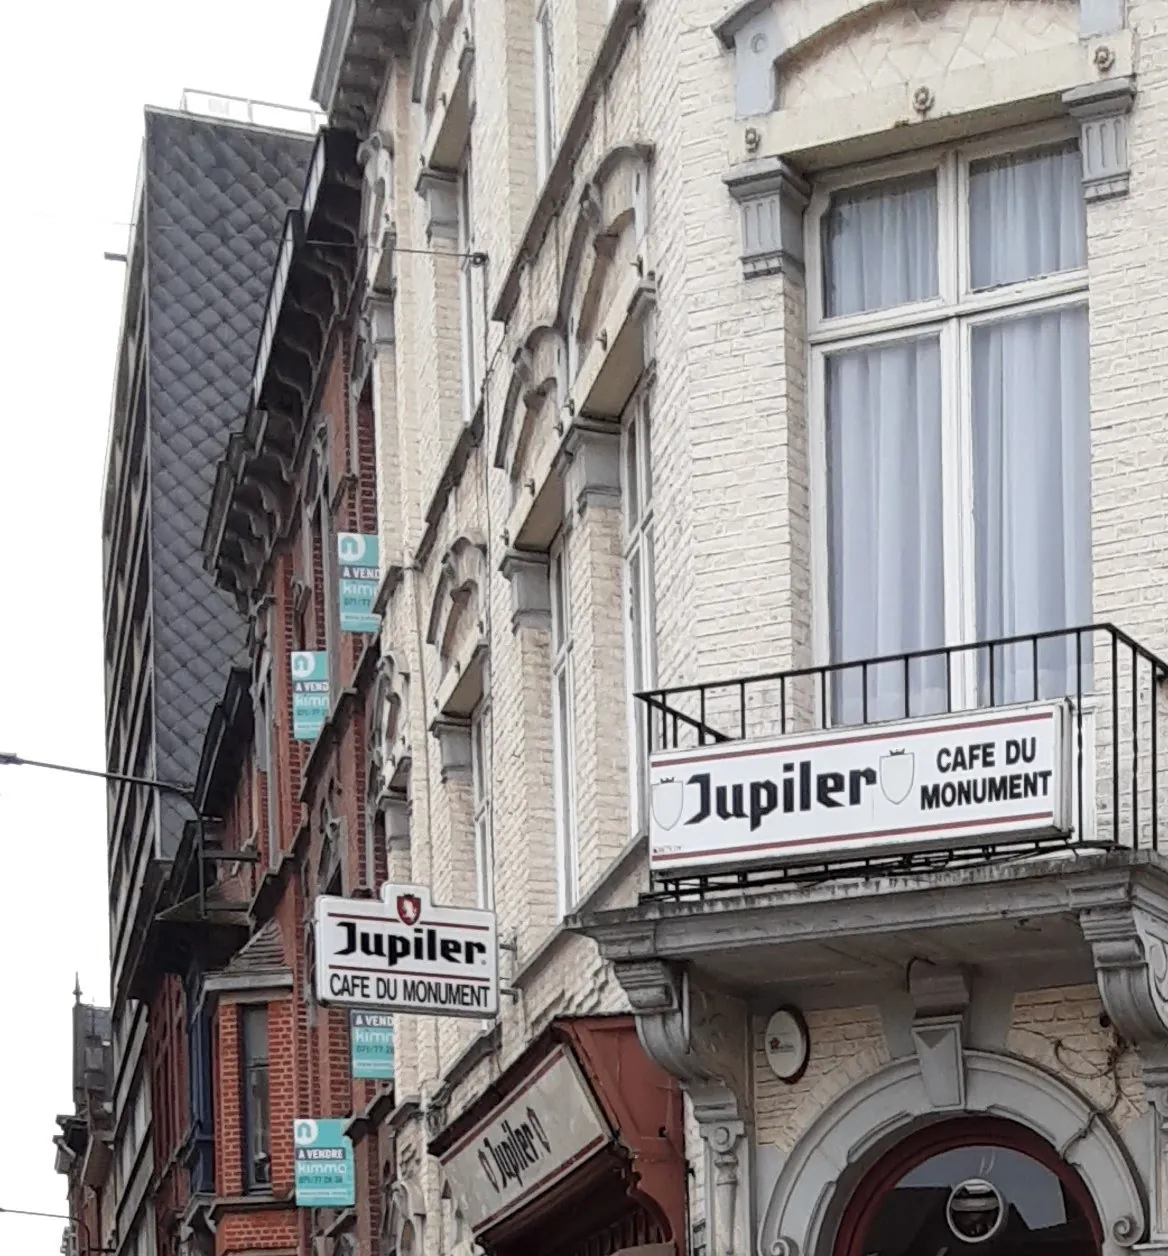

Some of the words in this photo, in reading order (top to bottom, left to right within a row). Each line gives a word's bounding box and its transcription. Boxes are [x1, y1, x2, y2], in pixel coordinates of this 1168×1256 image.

[937, 742, 996, 773] CAFE
[1005, 737, 1037, 765] DU
[684, 760, 877, 832] Jupiler
[920, 770, 1053, 811] MONUMENT
[333, 921, 487, 966] Jupiler
[330, 973, 370, 999] CAFE
[376, 977, 397, 1000] DU
[403, 979, 490, 1007] MONUMENT
[308, 1149, 344, 1159] VENDRE
[483, 1119, 540, 1190] Jupiler
